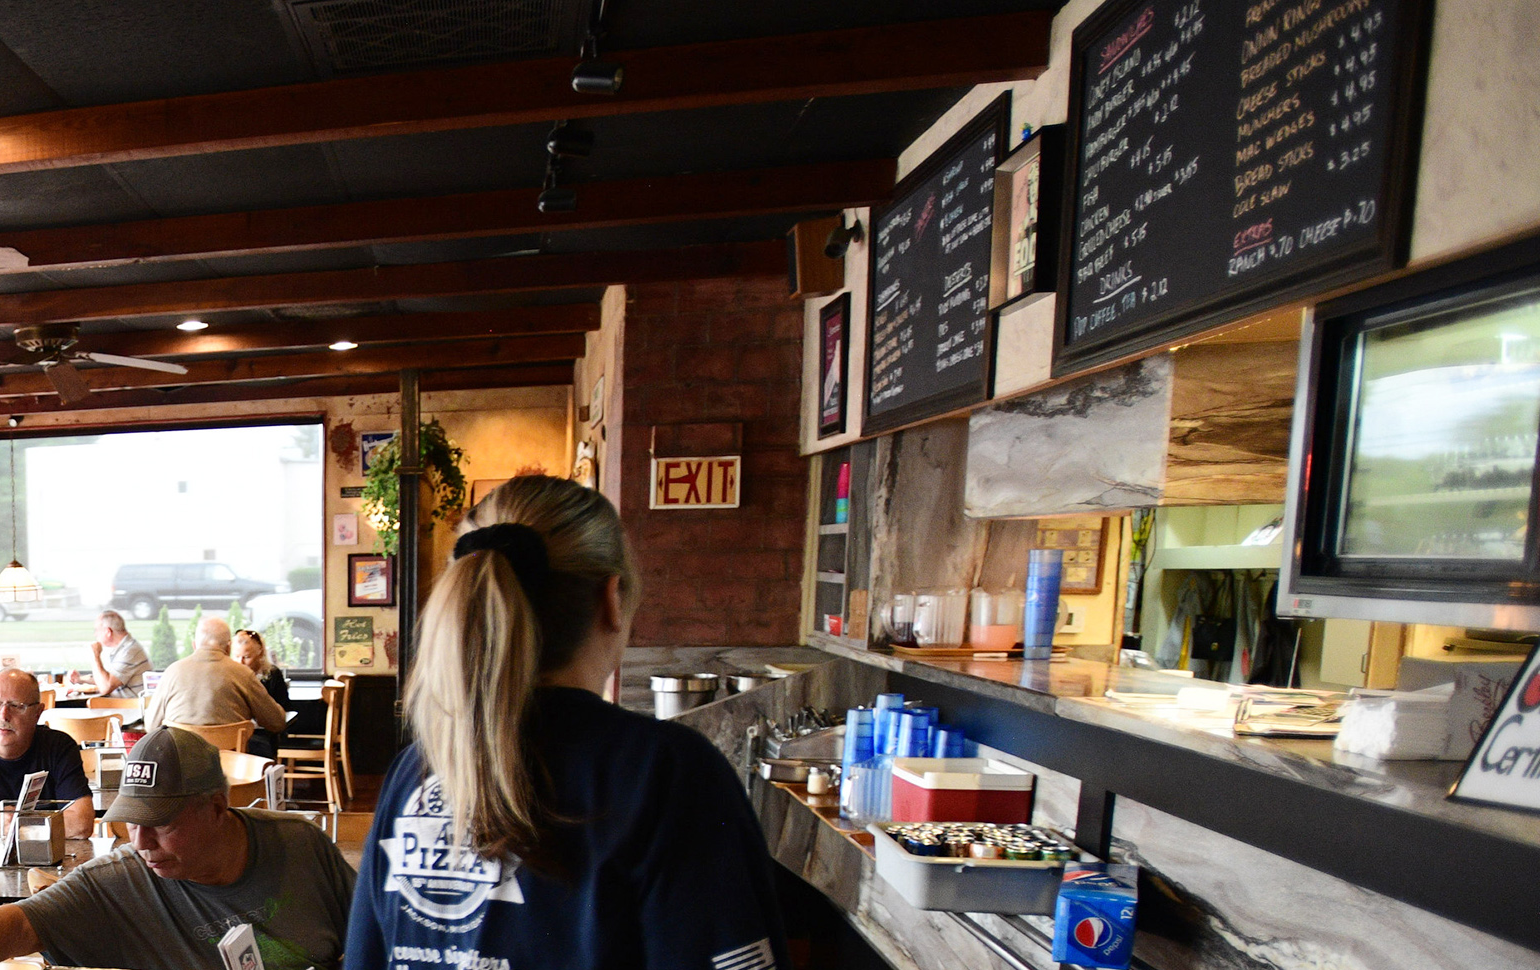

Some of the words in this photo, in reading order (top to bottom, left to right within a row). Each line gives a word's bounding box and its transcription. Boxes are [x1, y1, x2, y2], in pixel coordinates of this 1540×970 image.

[1234, 164, 1274, 198] BREAD
[1277, 140, 1314, 173] STICKS
[1232, 193, 1257, 219] COLE
[1260, 180, 1292, 206] SLAW
[1227, 246, 1266, 278] RANCH
[1298, 216, 1342, 249] CHEESE
[1099, 260, 1133, 295] DRINKS
[663, 460, 734, 504] EXIT
[127, 764, 151, 779] USA
[1103, 933, 1124, 957] pepsi
